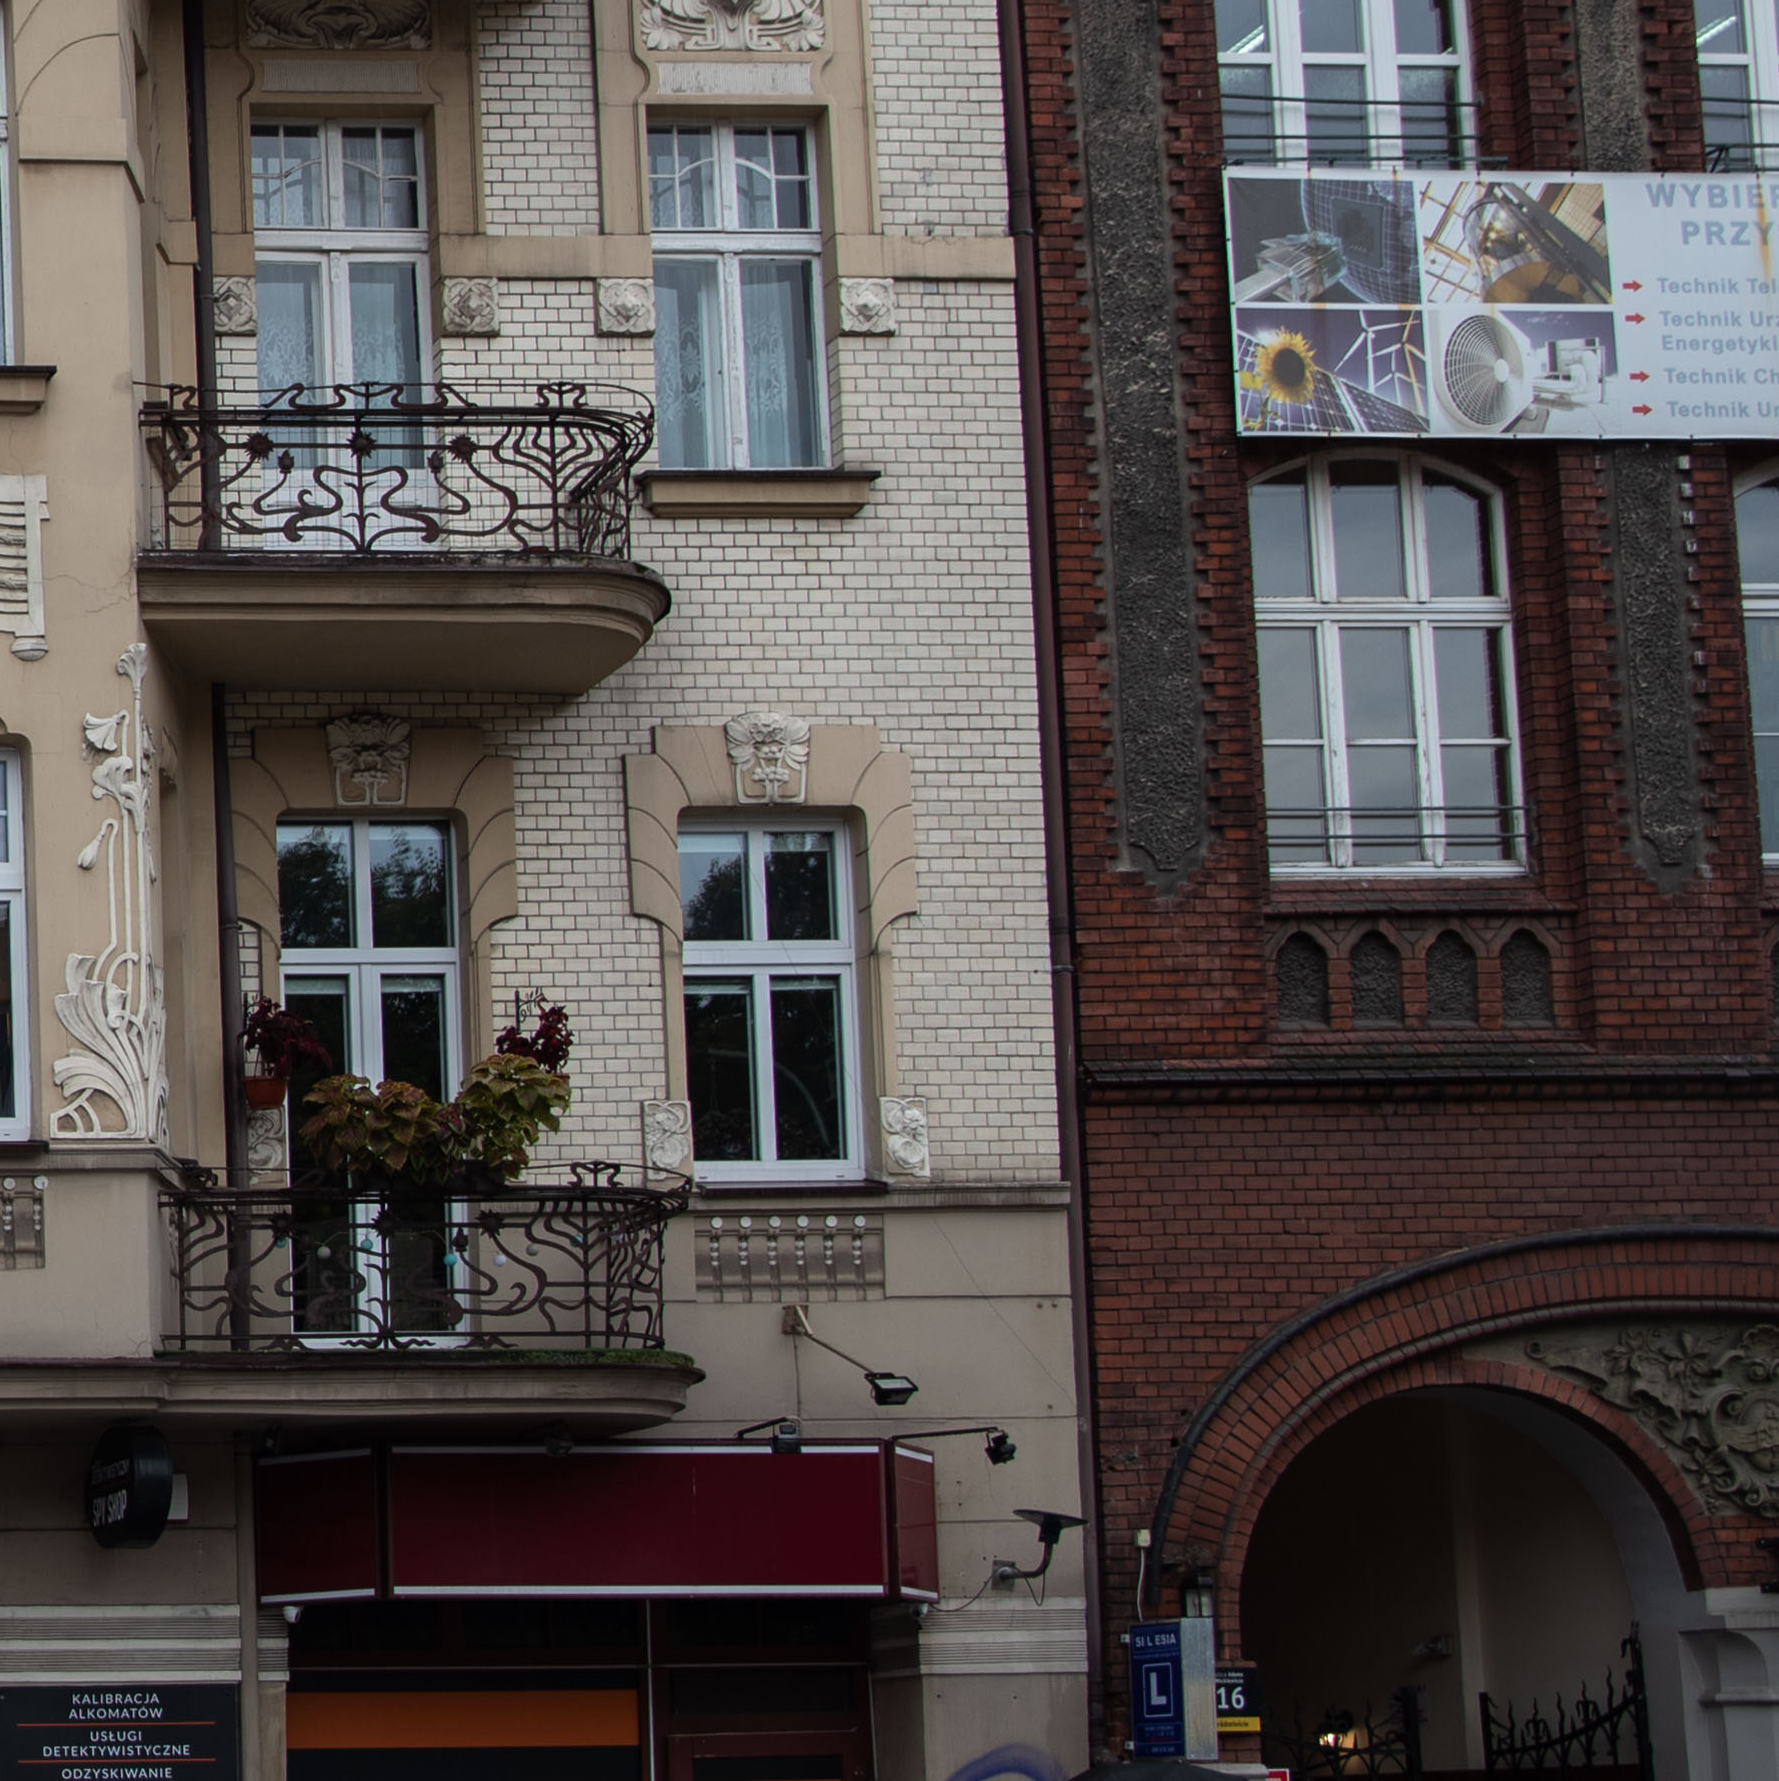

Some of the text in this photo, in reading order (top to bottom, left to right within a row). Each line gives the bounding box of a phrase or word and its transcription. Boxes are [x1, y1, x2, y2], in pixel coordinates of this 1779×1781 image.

[1681, 220, 1779, 246] PRZY
[1657, 278, 1779, 294] Technik Tel
[1659, 310, 1742, 327] Technik
[1661, 334, 1778, 355] Energetyki
[1664, 368, 1746, 385] Technik
[1667, 401, 1748, 418] Technik
[1149, 1672, 1167, 1705] L
[71, 1693, 160, 1706] KALIBRACJA
[1216, 1686, 1245, 1709] 16
[68, 1706, 163, 1720] ALKOMATÓW
[90, 1731, 143, 1743] USŁUGI
[42, 1744, 191, 1758] DETEKTYWISTYCZNE
[62, 1767, 173, 1780] ODZYSKIWANIE
